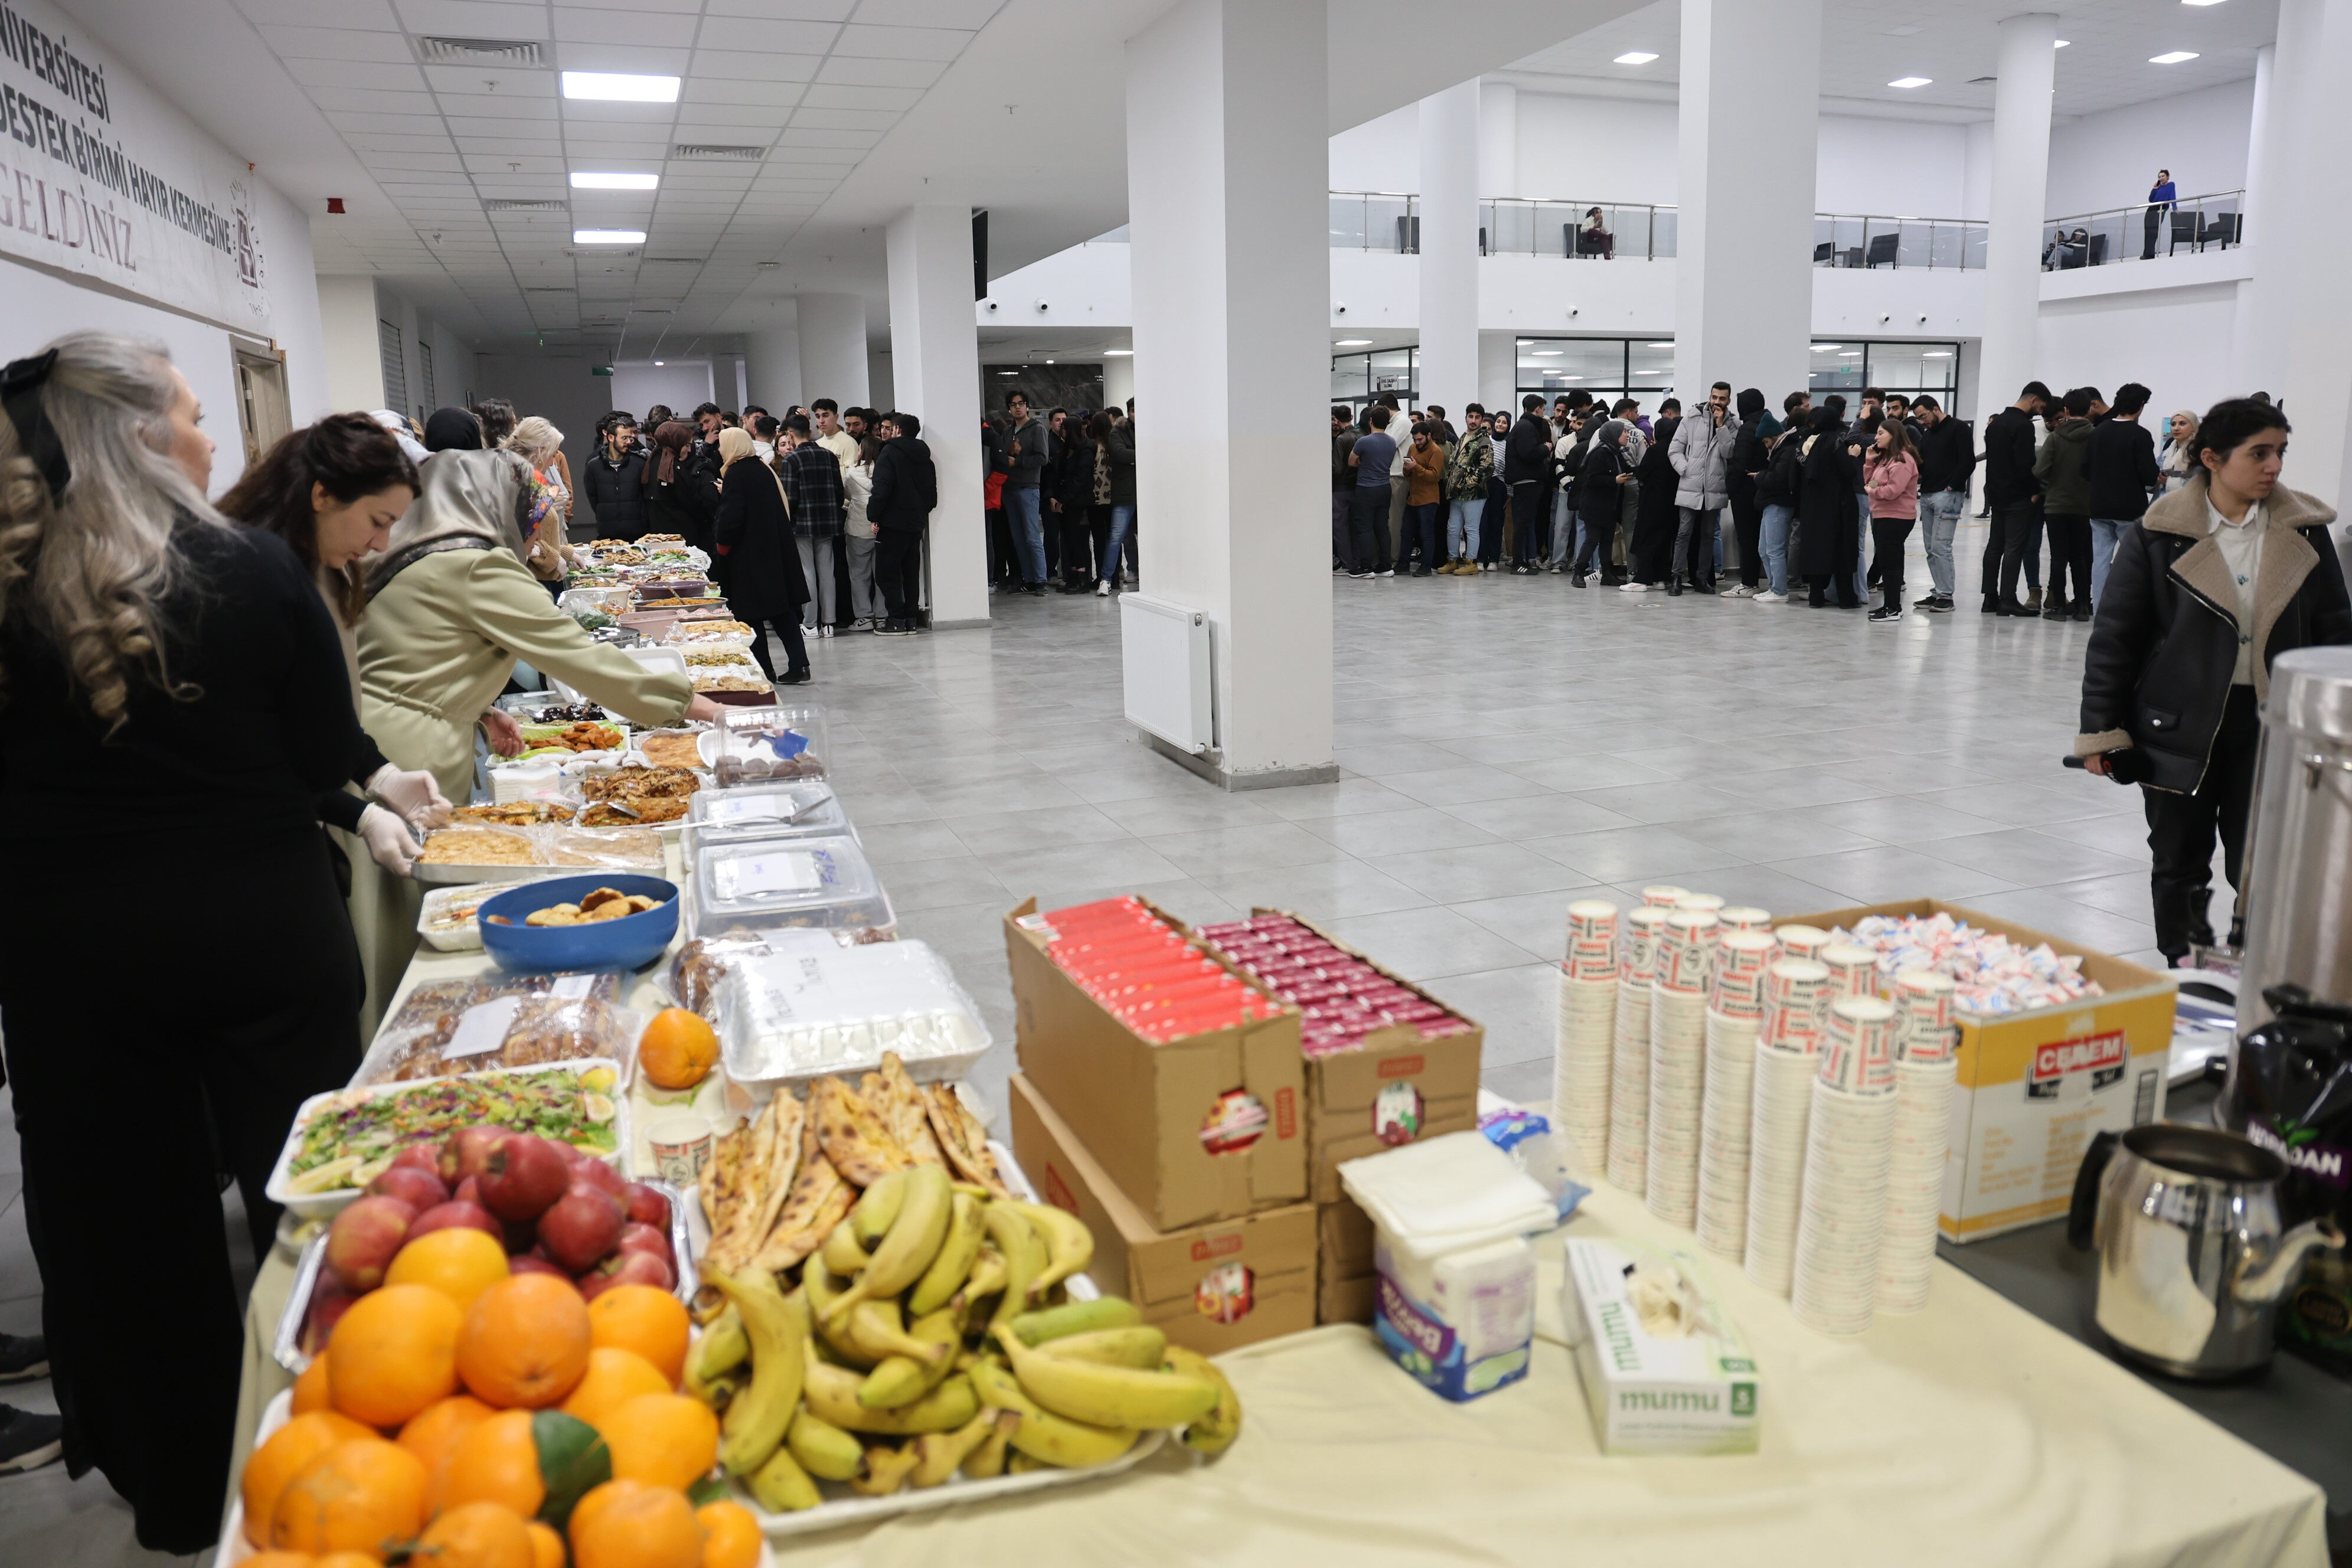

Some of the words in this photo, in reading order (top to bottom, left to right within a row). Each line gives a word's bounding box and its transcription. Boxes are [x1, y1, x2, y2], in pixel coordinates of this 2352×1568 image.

[72, 116, 130, 199] BİRİMİ
[128, 159, 172, 222] HAYIR
[169, 185, 231, 255] KERMESİNE
[1619, 1389, 1720, 1413] mumu
